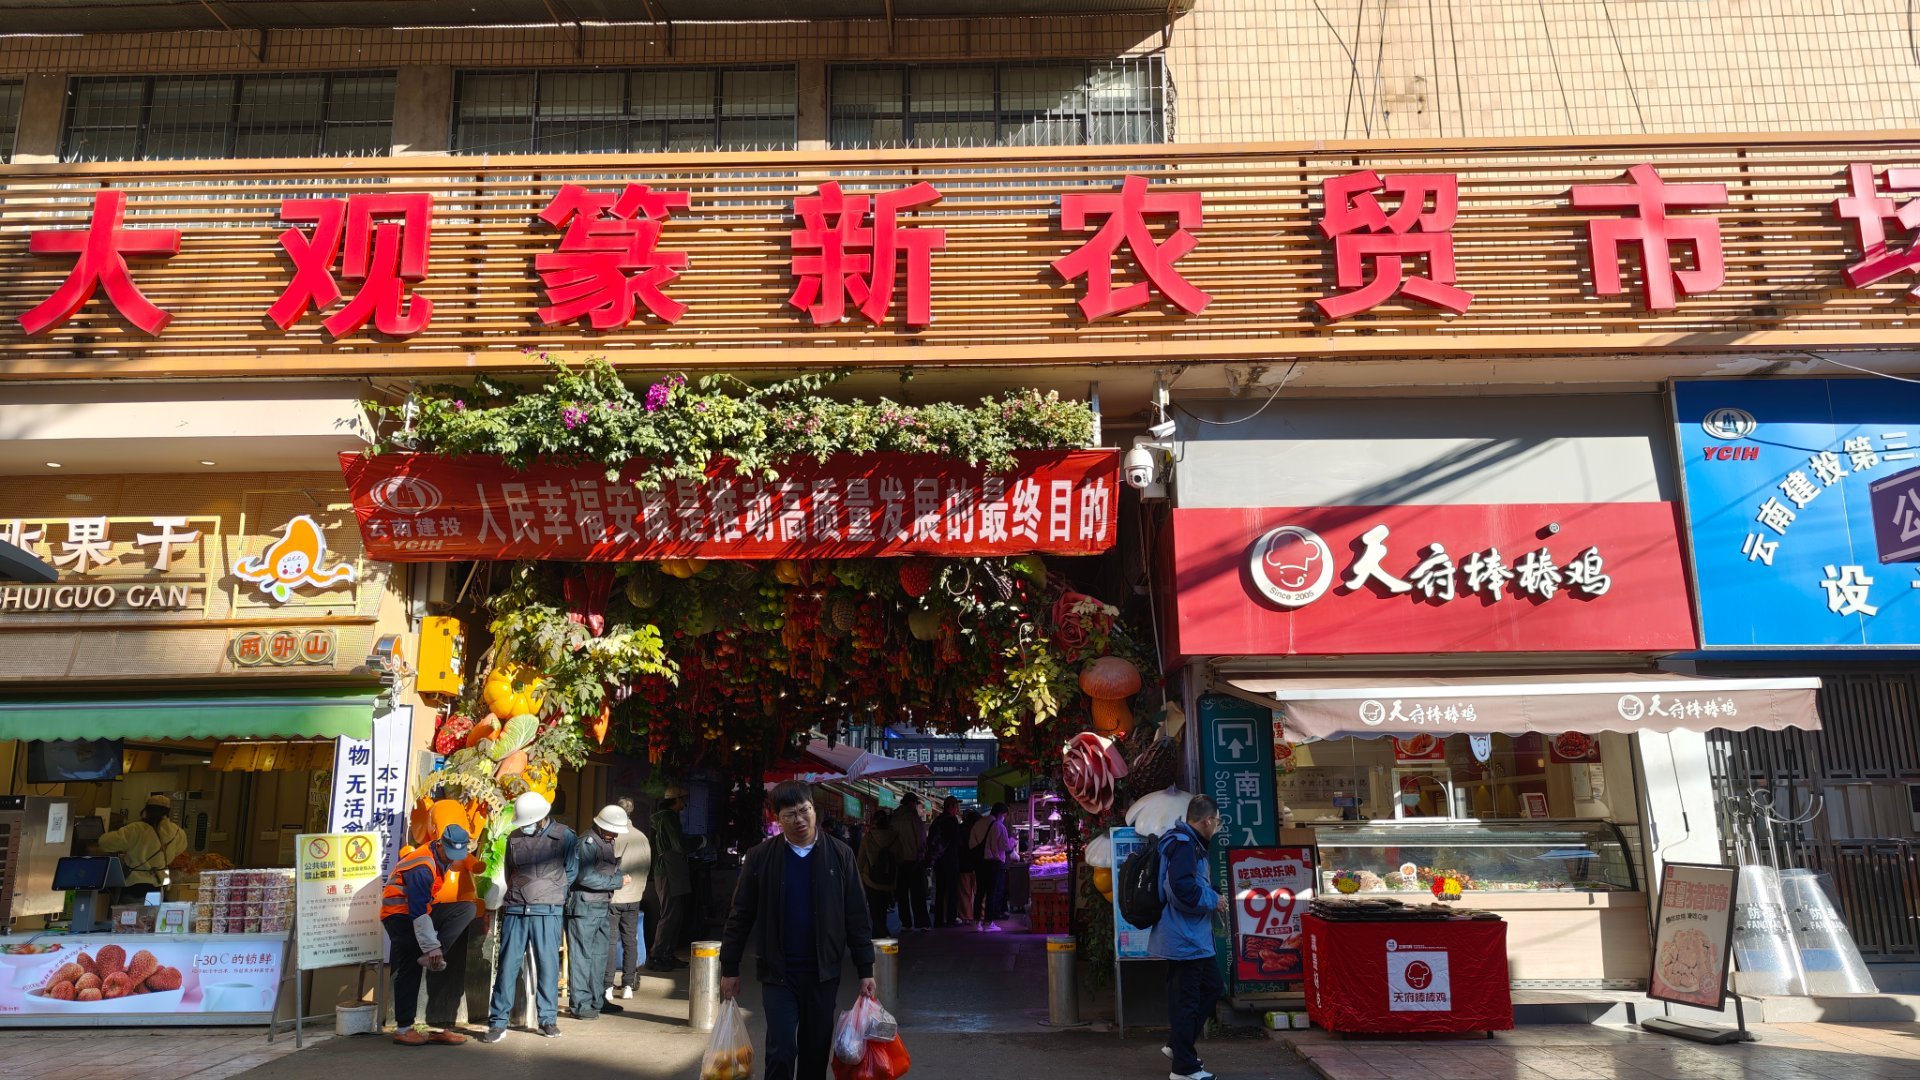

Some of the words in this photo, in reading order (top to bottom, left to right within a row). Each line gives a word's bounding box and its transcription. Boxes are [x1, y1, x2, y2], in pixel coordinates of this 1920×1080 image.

[18, 163, 1920, 338] 大观篆新农贸市场
[1703, 446, 1760, 461] YCIH
[367, 516, 463, 537] 云南建投
[477, 477, 1109, 545] 人民幸福安康是推动高质量发展的最终目的
[393, 540, 443, 551] YCIH
[1346, 523, 1611, 601] 天府棒棒鸡
[0, 585, 116, 609] HUIGUO
[127, 584, 189, 607] GAN
[1269, 586, 1291, 601] Since
[1294, 590, 1315, 601] 2005
[1821, 564, 1920, 616] 设
[1214, 770, 1230, 809] South
[1234, 770, 1263, 847] 南门入
[1218, 813, 1233, 847] Gate
[1244, 888, 1296, 934] 9.9
